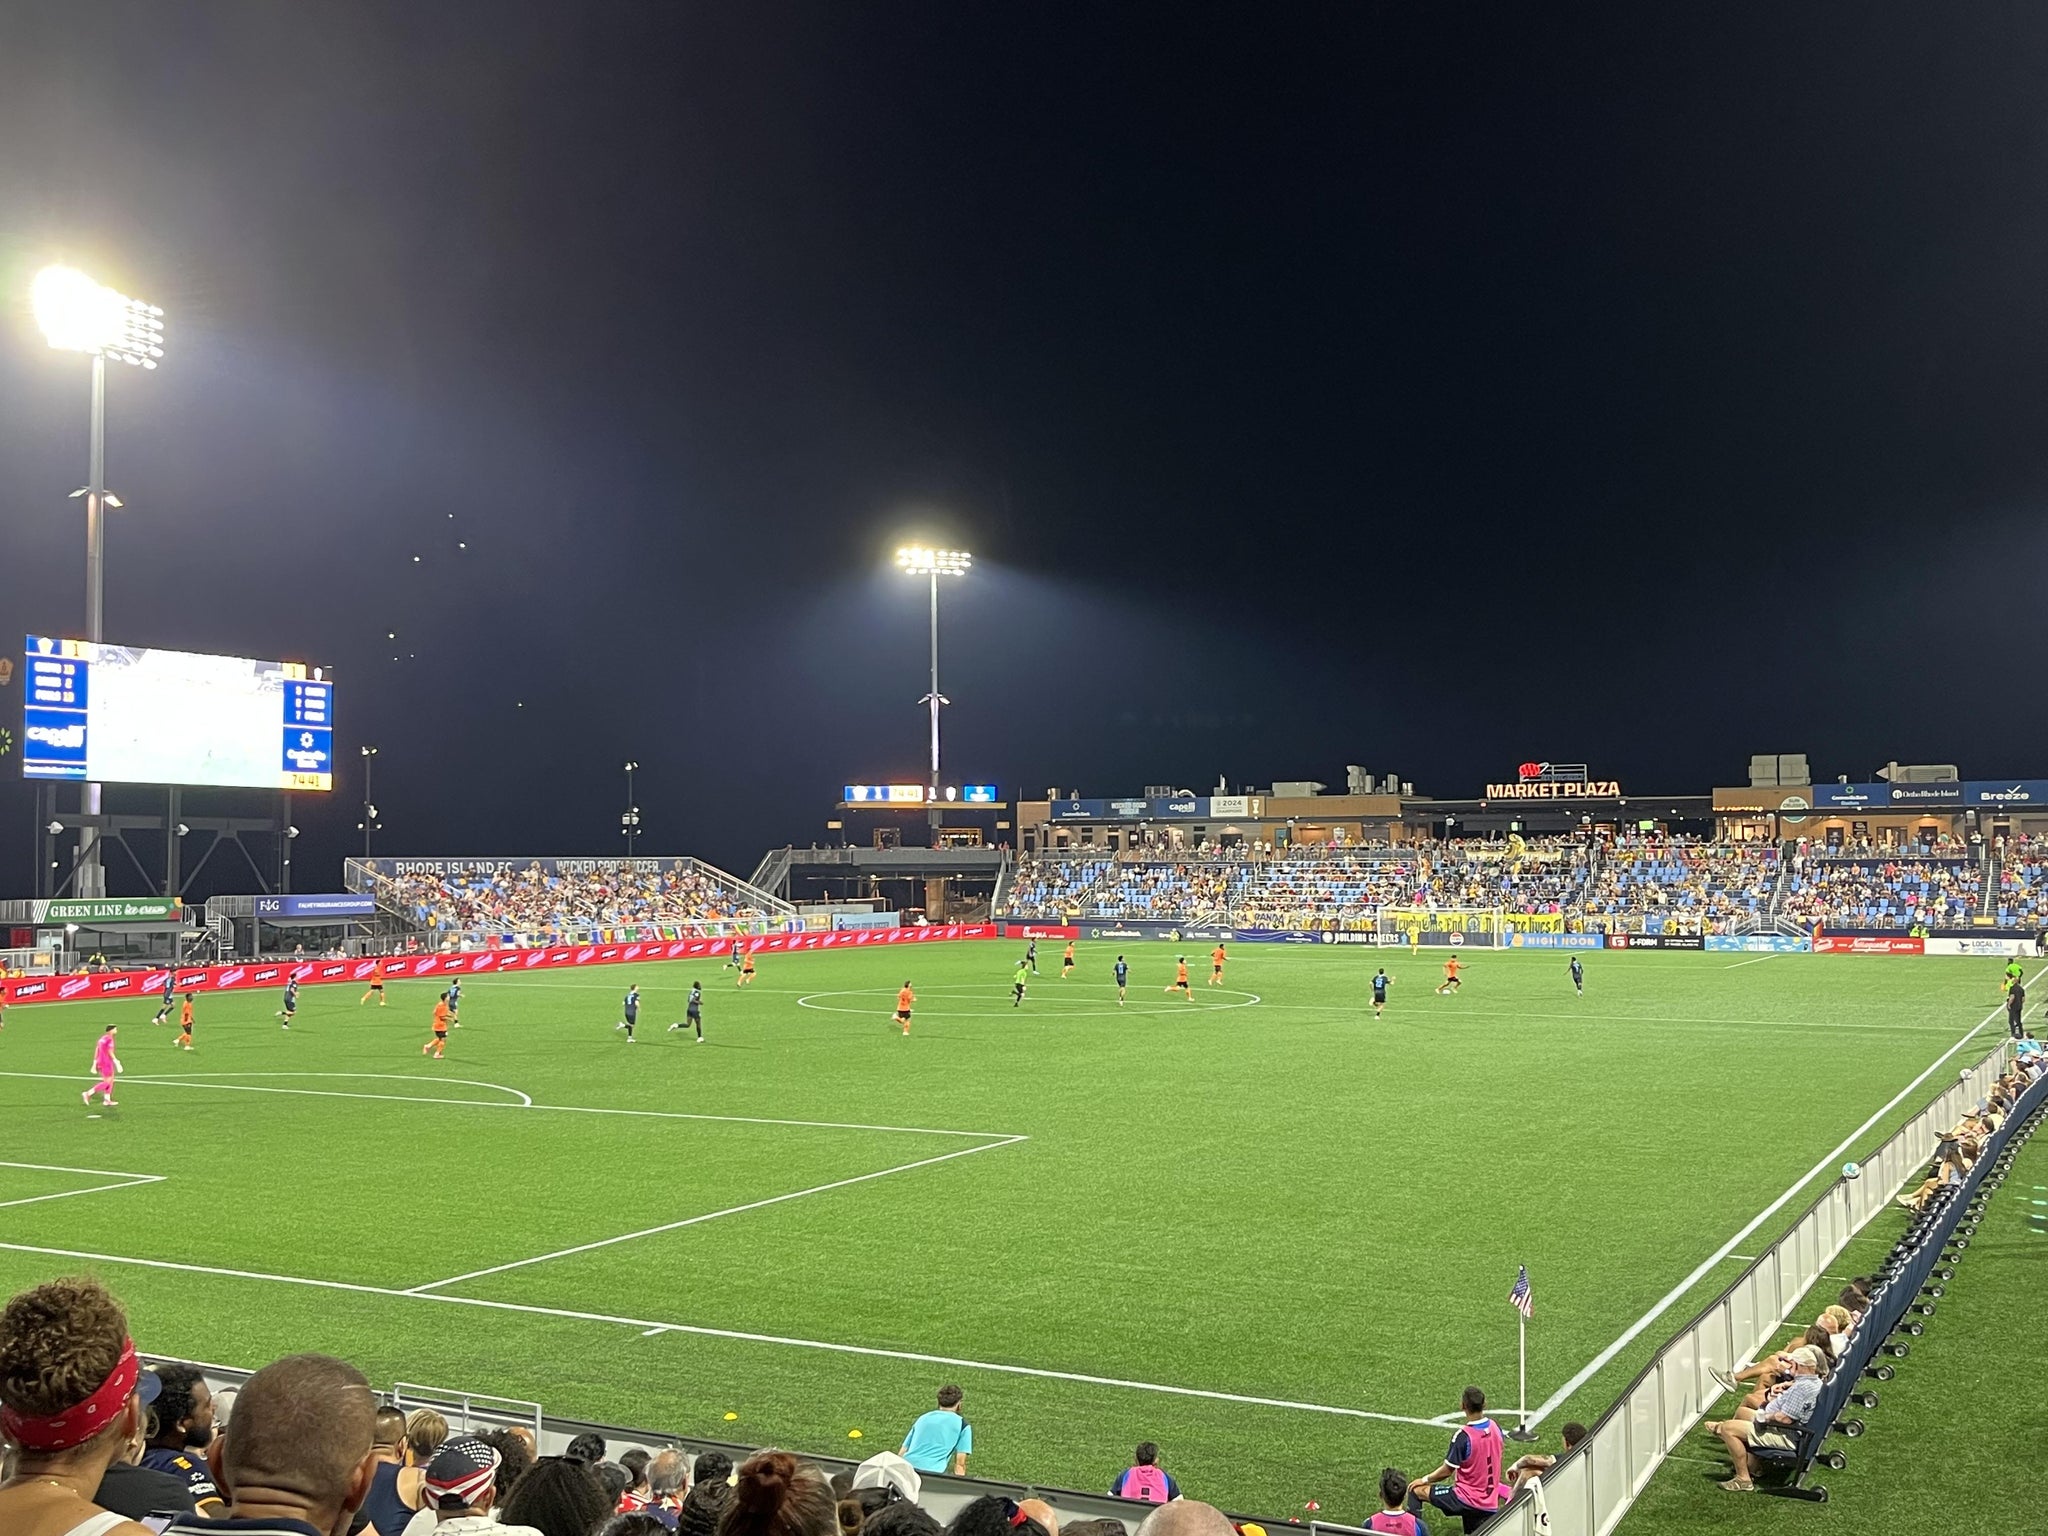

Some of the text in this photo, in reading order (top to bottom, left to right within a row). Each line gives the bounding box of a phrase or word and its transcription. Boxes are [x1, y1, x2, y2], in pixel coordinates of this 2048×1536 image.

[73, 644, 79, 656] 1
[1486, 781, 1621, 798] MARKET PLAZA
[1980, 792, 2030, 801] Breeze
[395, 861, 514, 874] RHODE ISLAND FC
[556, 860, 597, 874] WICKED
[51, 903, 167, 917] GREEN LINE ice cream
[1335, 932, 1367, 943] BUILDING
[1528, 937, 1596, 946] HIGH NOON
[1629, 938, 1658, 947] G-FORM
